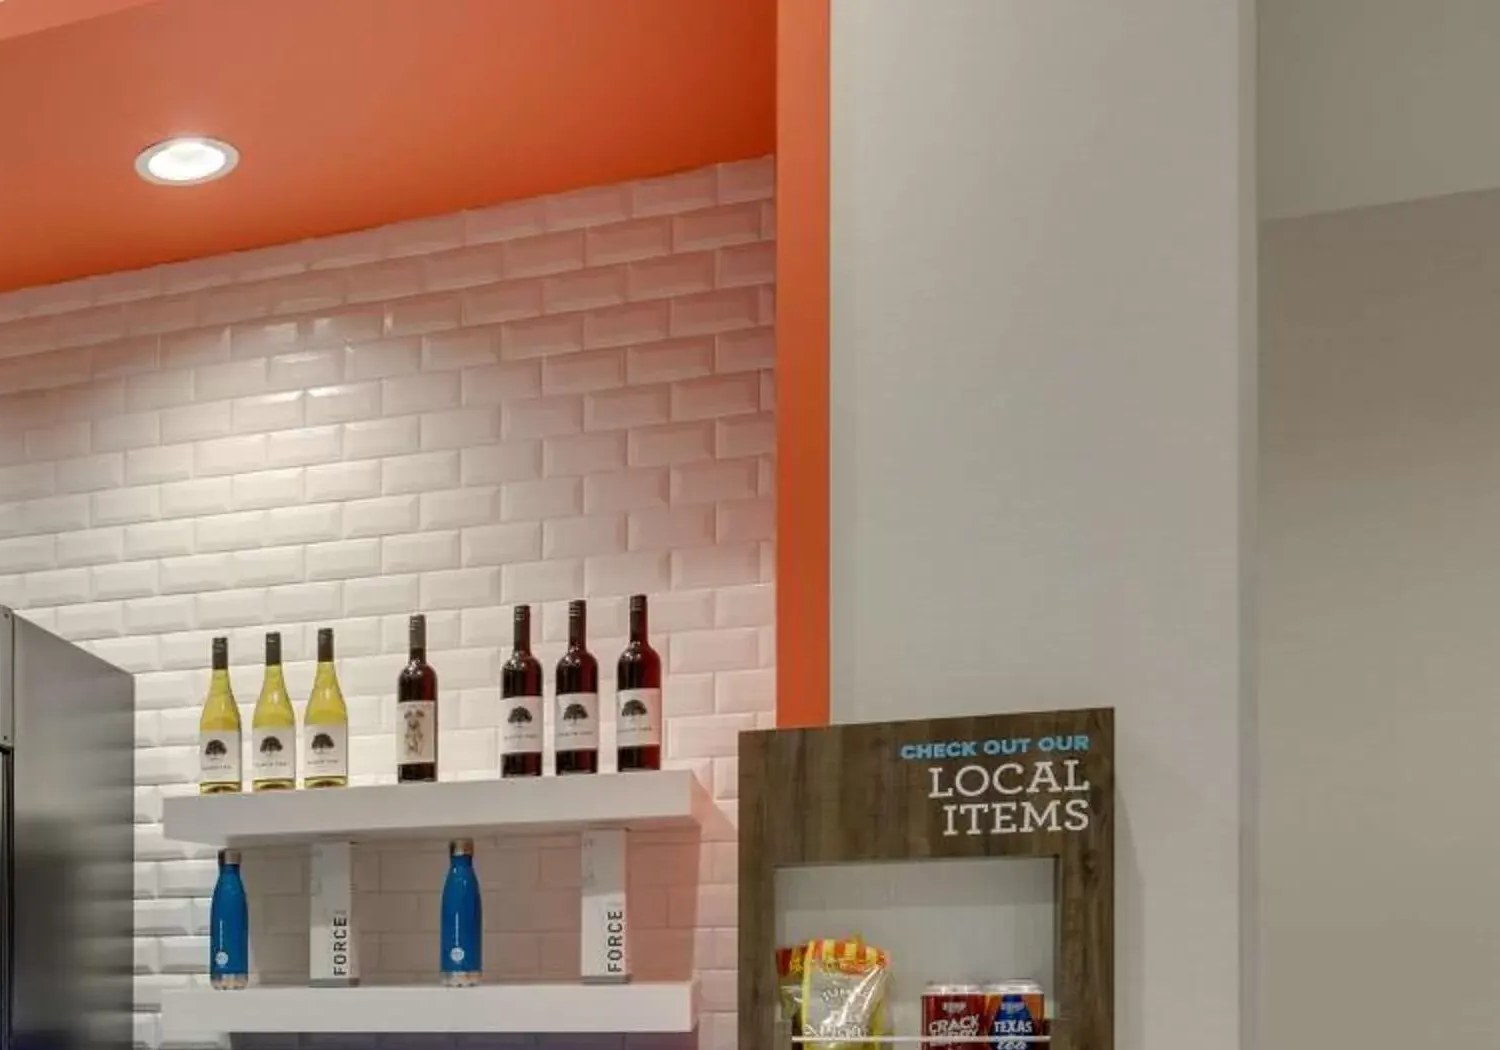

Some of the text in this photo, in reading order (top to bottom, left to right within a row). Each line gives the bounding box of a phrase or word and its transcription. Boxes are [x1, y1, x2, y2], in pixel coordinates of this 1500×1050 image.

[900, 735, 1089, 760] CHECK OUT OUR
[927, 760, 1090, 799] LOCAL
[943, 799, 1090, 836] ITEMS
[333, 915, 348, 976] FORCE
[608, 910, 623, 973] FORCE
[994, 1020, 1033, 1033] TEXAS
